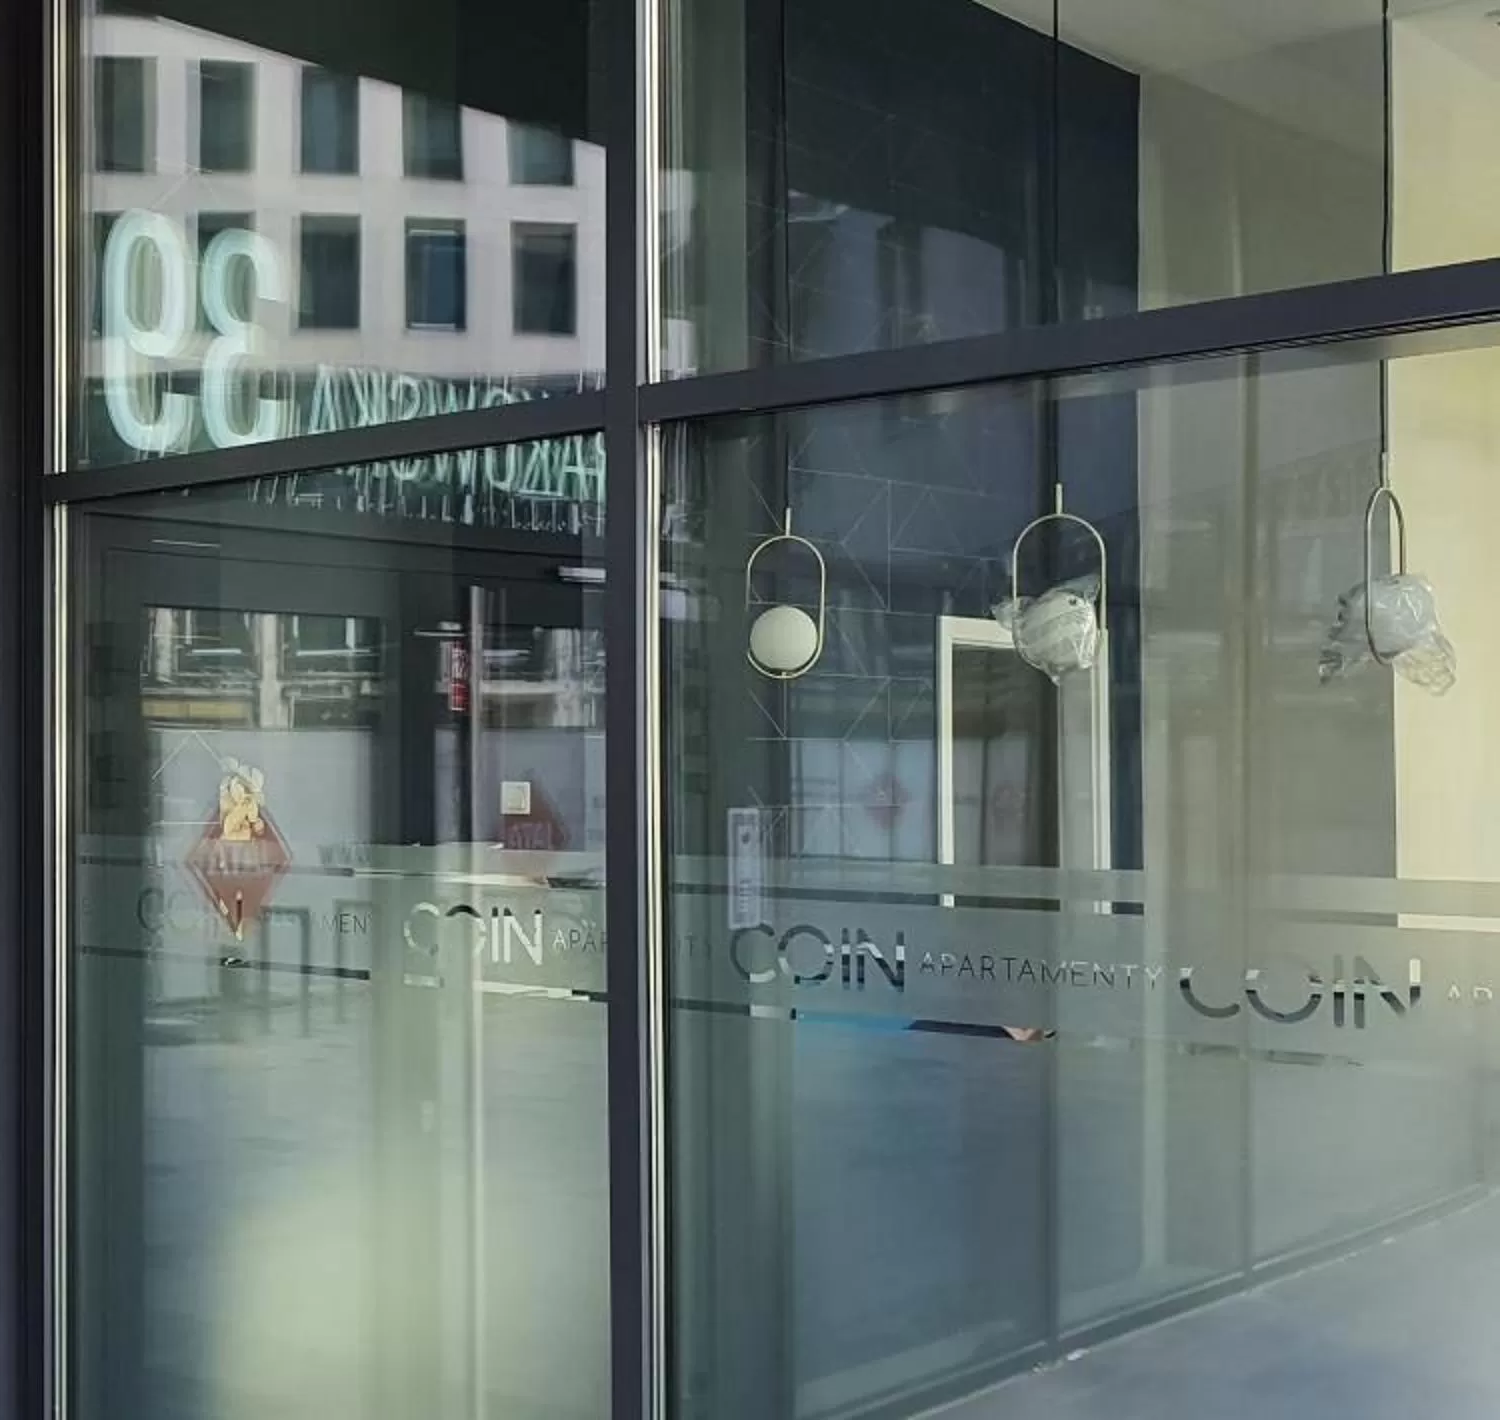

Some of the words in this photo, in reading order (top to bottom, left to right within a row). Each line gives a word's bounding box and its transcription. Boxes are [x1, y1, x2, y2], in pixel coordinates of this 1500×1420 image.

[403, 902, 544, 965] COIN
[730, 922, 905, 992] COIN
[919, 951, 1163, 989] APARTAMENTY
